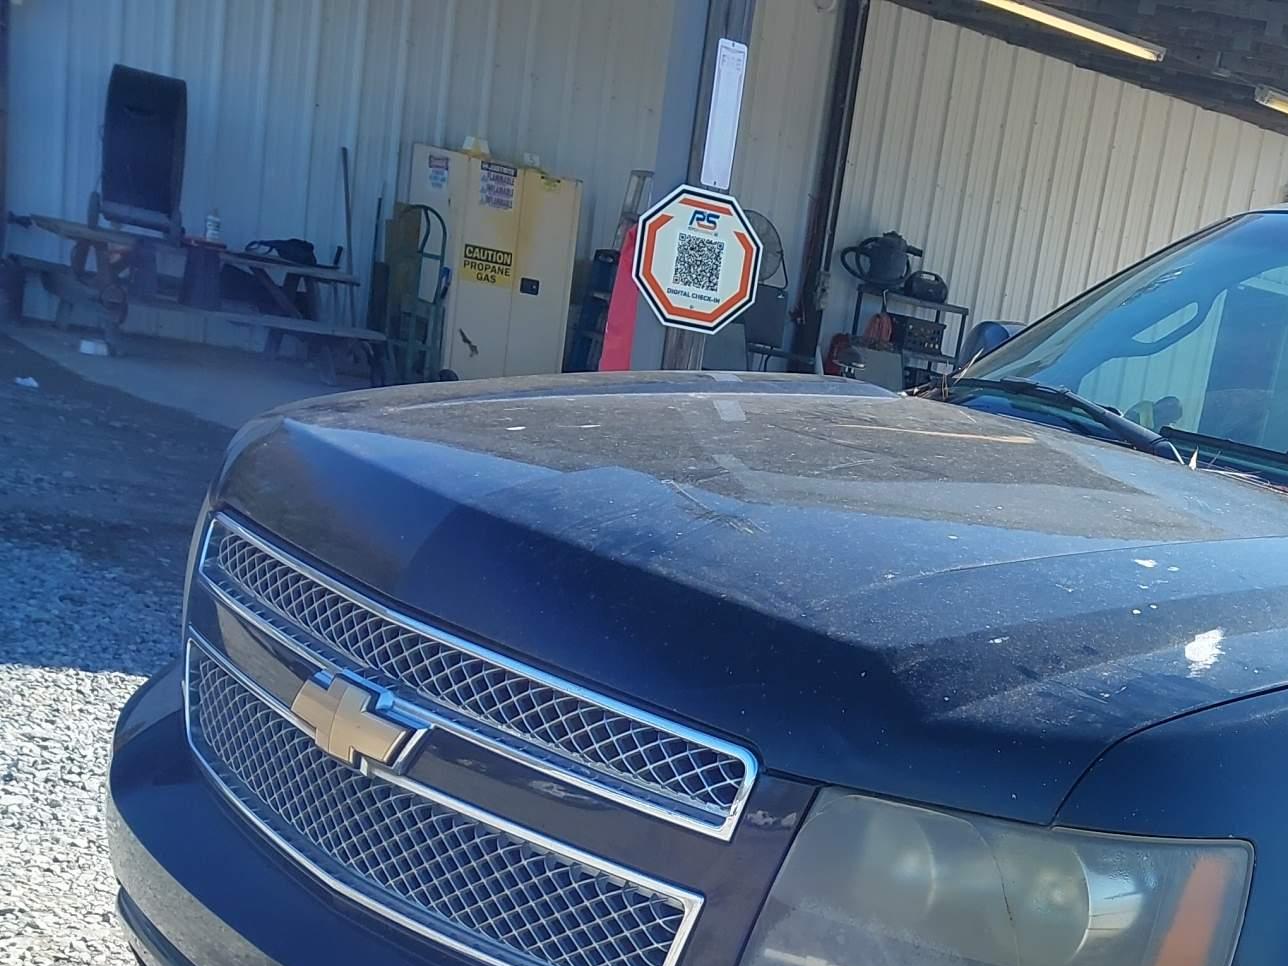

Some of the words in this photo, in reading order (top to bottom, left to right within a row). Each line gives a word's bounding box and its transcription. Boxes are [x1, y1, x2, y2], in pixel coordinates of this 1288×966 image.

[466, 246, 511, 265] CAUTION
[464, 259, 511, 277] PROPANE
[476, 271, 497, 284] GAS
[666, 287, 690, 298] DIGITAL
[691, 293, 720, 304] CHECK-IN
